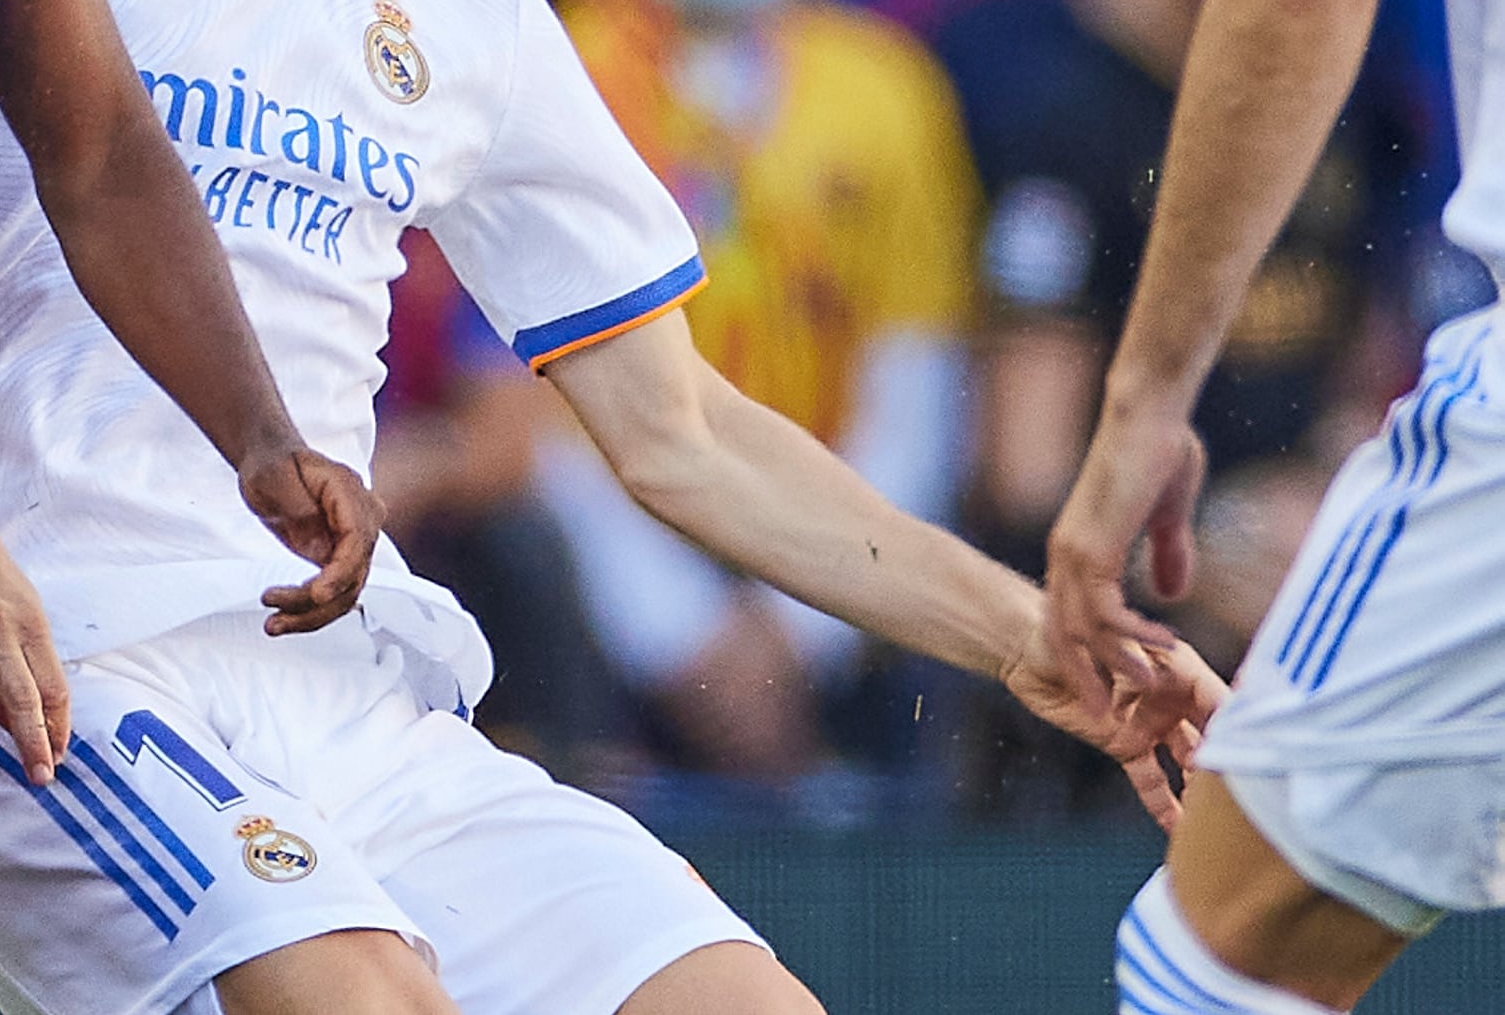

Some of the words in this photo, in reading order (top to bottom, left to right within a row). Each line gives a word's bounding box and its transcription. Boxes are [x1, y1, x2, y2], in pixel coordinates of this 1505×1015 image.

[138, 67, 420, 213] mirates
[203, 166, 353, 265] BETTER
[111, 709, 249, 812] 1
